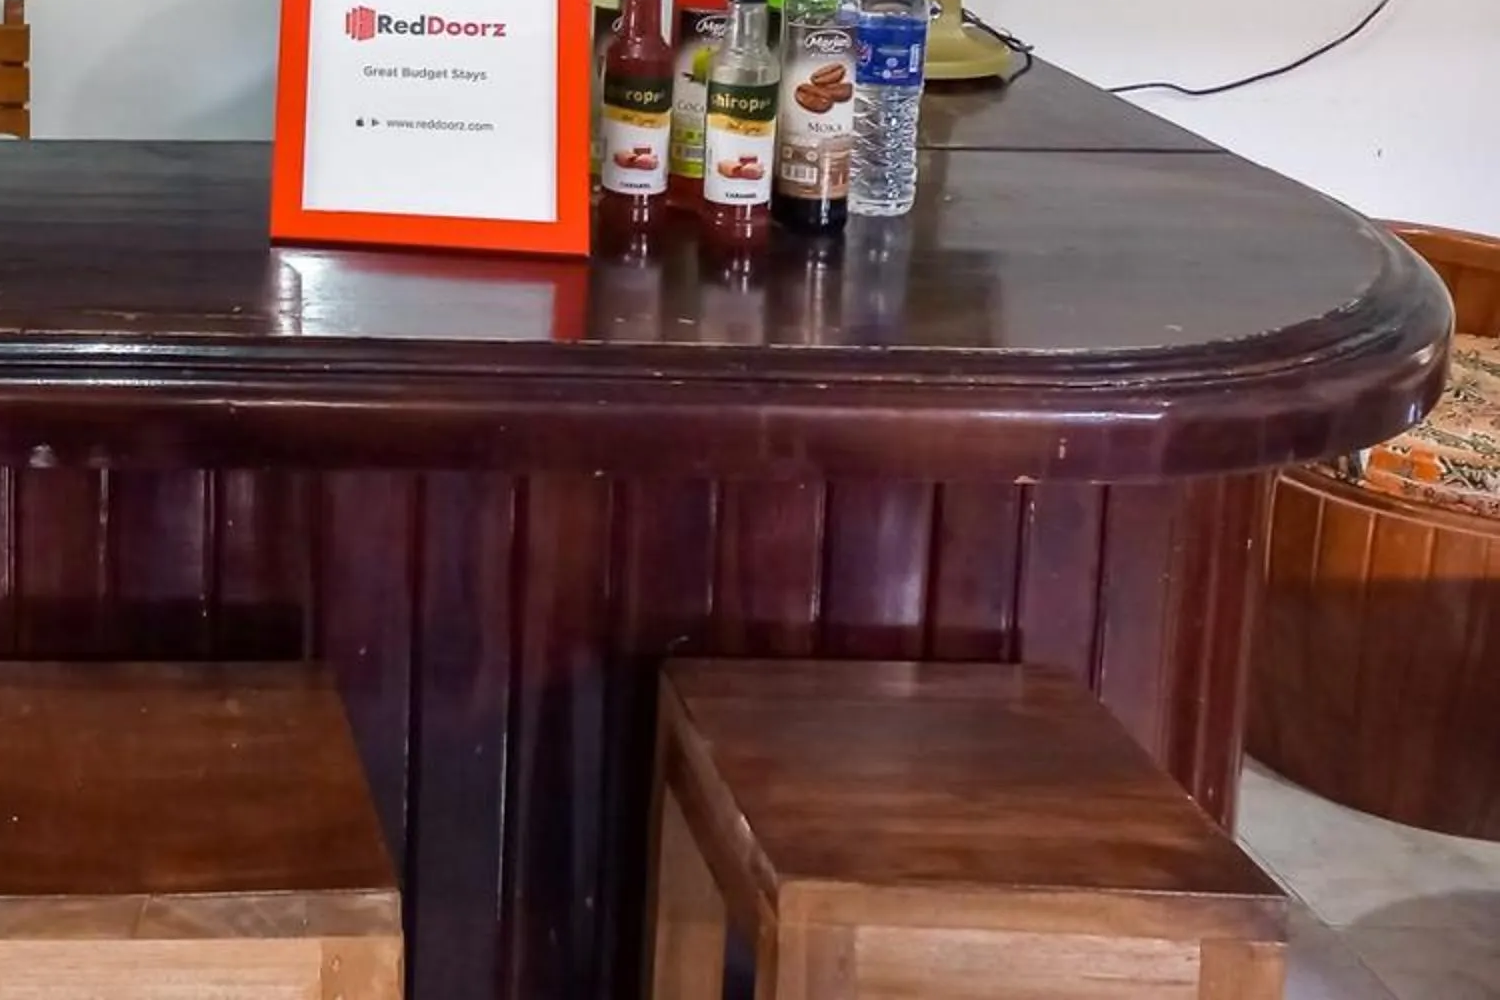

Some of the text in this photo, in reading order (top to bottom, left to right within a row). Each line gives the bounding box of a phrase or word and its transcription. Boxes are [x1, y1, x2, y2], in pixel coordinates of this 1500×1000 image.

[377, 13, 507, 38] RedDoorz
[363, 65, 488, 82] Great Budget Stays
[386, 118, 496, 132] www.reddoorz.com
